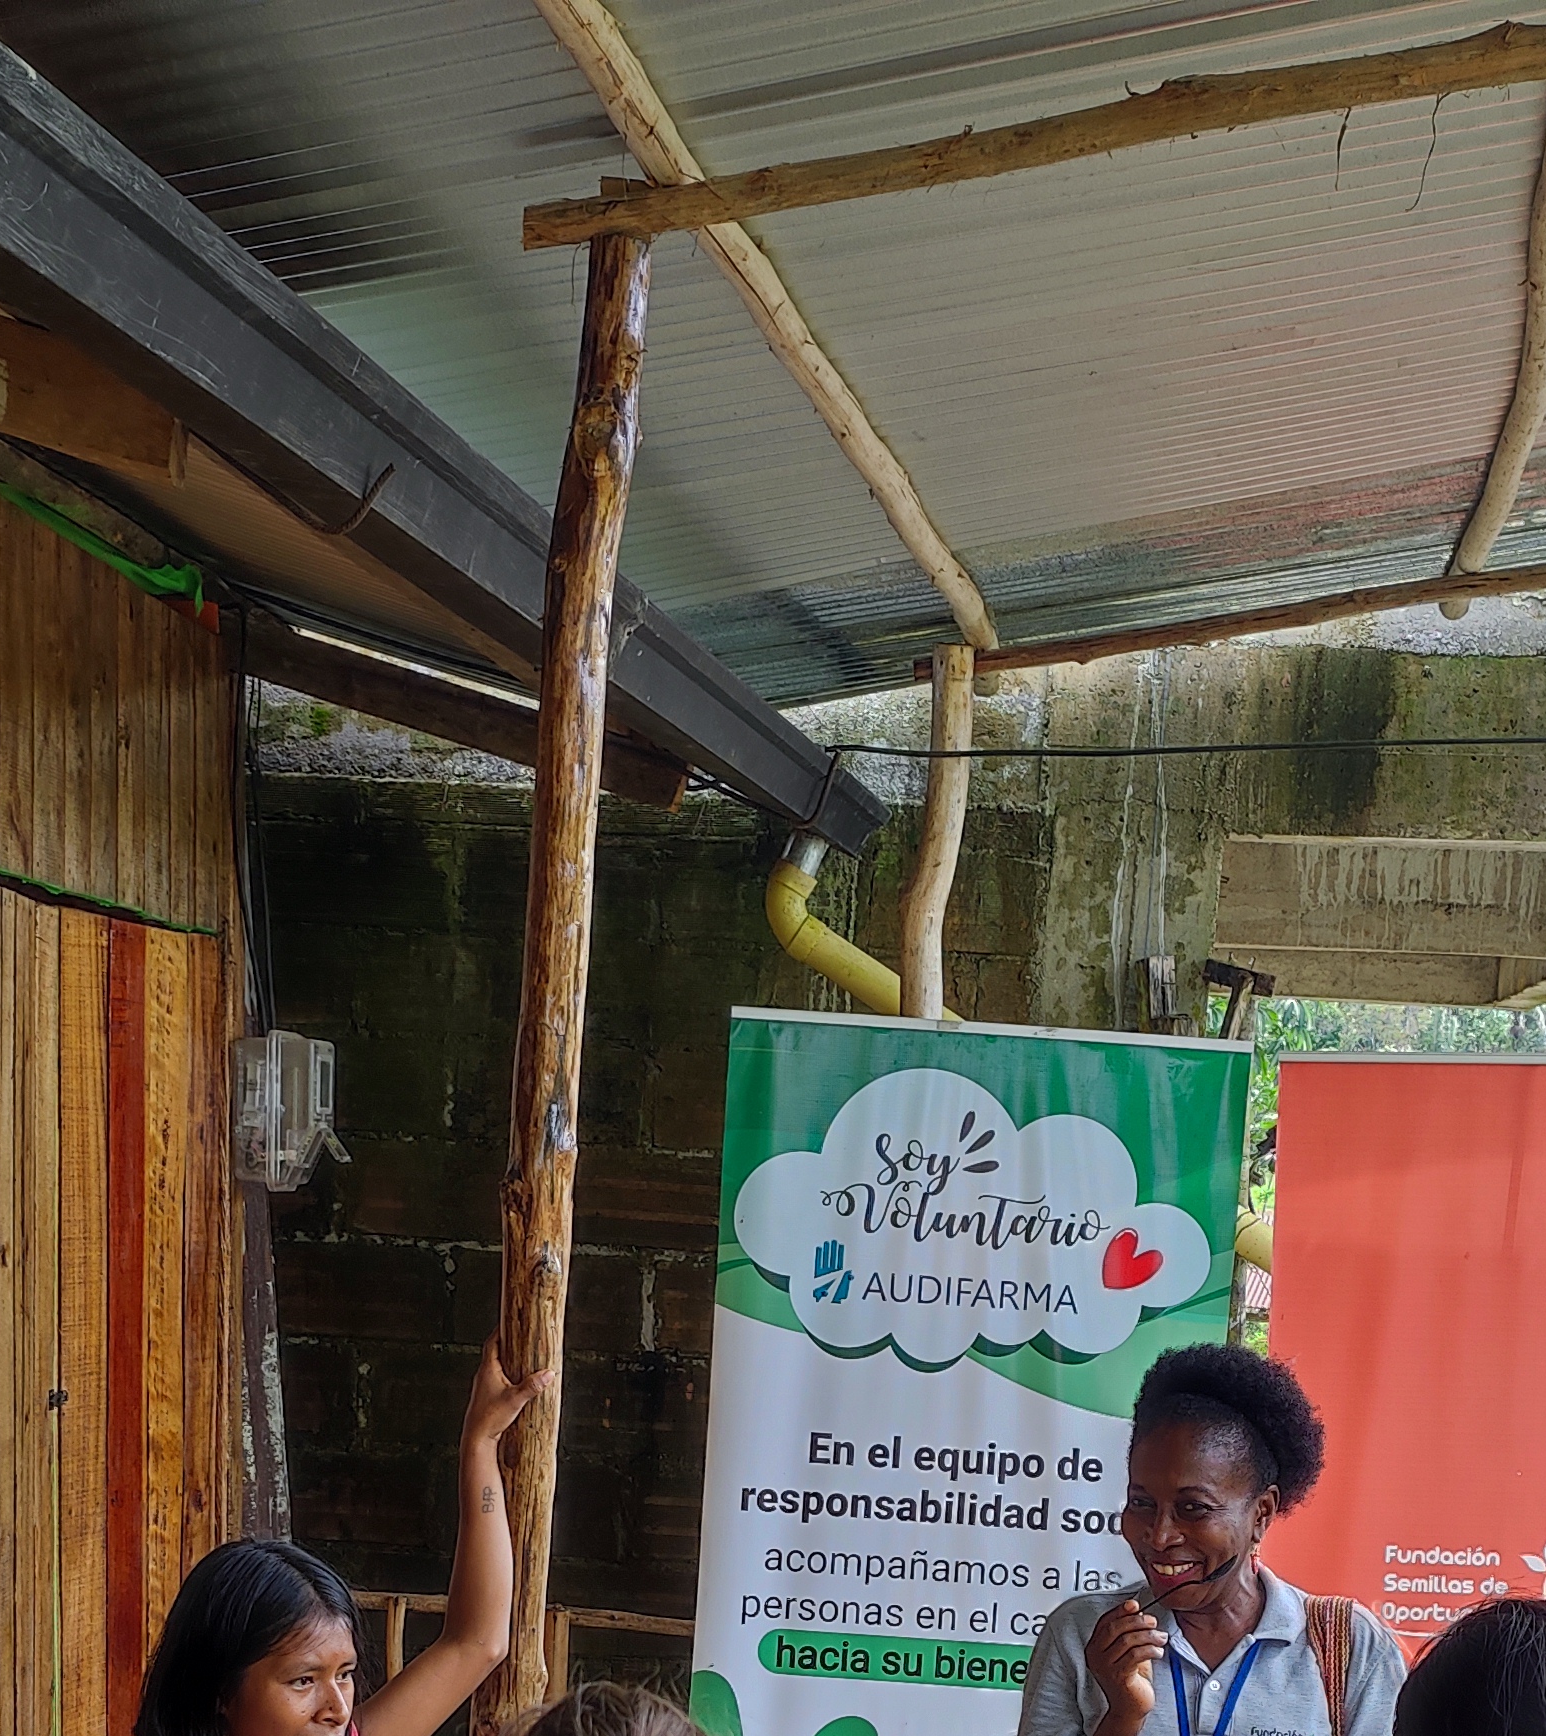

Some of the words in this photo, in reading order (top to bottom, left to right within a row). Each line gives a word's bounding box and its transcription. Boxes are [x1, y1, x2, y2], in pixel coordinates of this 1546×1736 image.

[874, 1132, 962, 1196] Soy
[821, 1180, 1112, 1251] Voluntario
[861, 1271, 1079, 1315] AUDIFARMA
[808, 1431, 855, 1467] En
[867, 1435, 902, 1471] el
[913, 1441, 1046, 1484] equipo
[1057, 1447, 1105, 1482] de
[739, 1484, 1050, 1532] responsabilidad
[1060, 1507, 1125, 1536] soc
[763, 1546, 1031, 1589] acompañamos
[1042, 1567, 1061, 1590] a
[1074, 1560, 1123, 1592] las
[1384, 1544, 1501, 1567] Fundación
[1383, 1572, 1475, 1594] Semillas
[1479, 1574, 1509, 1595] de
[740, 1592, 904, 1628] personas
[916, 1605, 956, 1632] en
[969, 1602, 998, 1634] el
[1010, 1612, 1048, 1637] ca
[1381, 1600, 1465, 1624] Oportu
[776, 1635, 871, 1675] hacia
[881, 1652, 922, 1679] su
[935, 1648, 1030, 1685] biene
